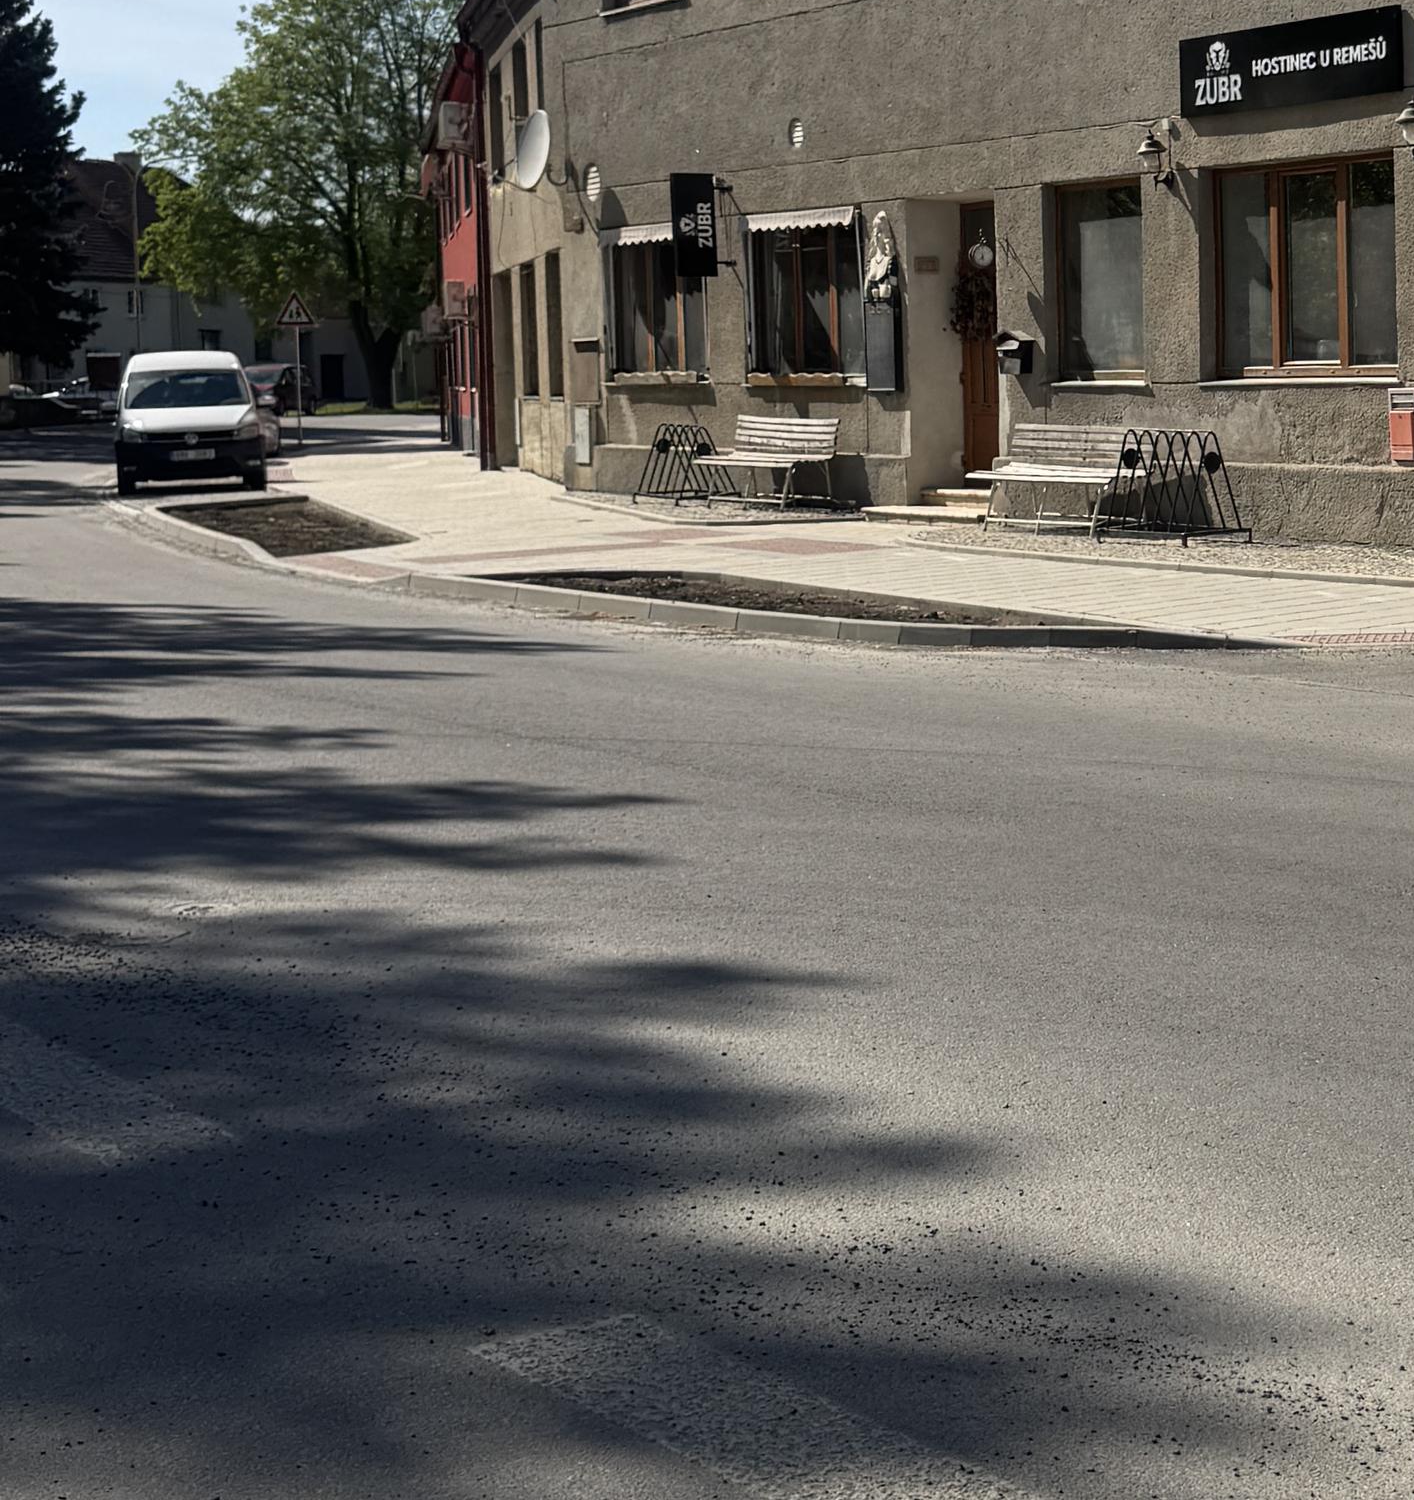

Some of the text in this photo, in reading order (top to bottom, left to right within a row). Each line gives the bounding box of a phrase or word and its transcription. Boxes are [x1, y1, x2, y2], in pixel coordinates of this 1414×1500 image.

[1252, 51, 1316, 77] HOSTINEC
[1320, 49, 1330, 67] U
[1194, 73, 1242, 106] ZUBR
[696, 202, 713, 248] ZUBR
